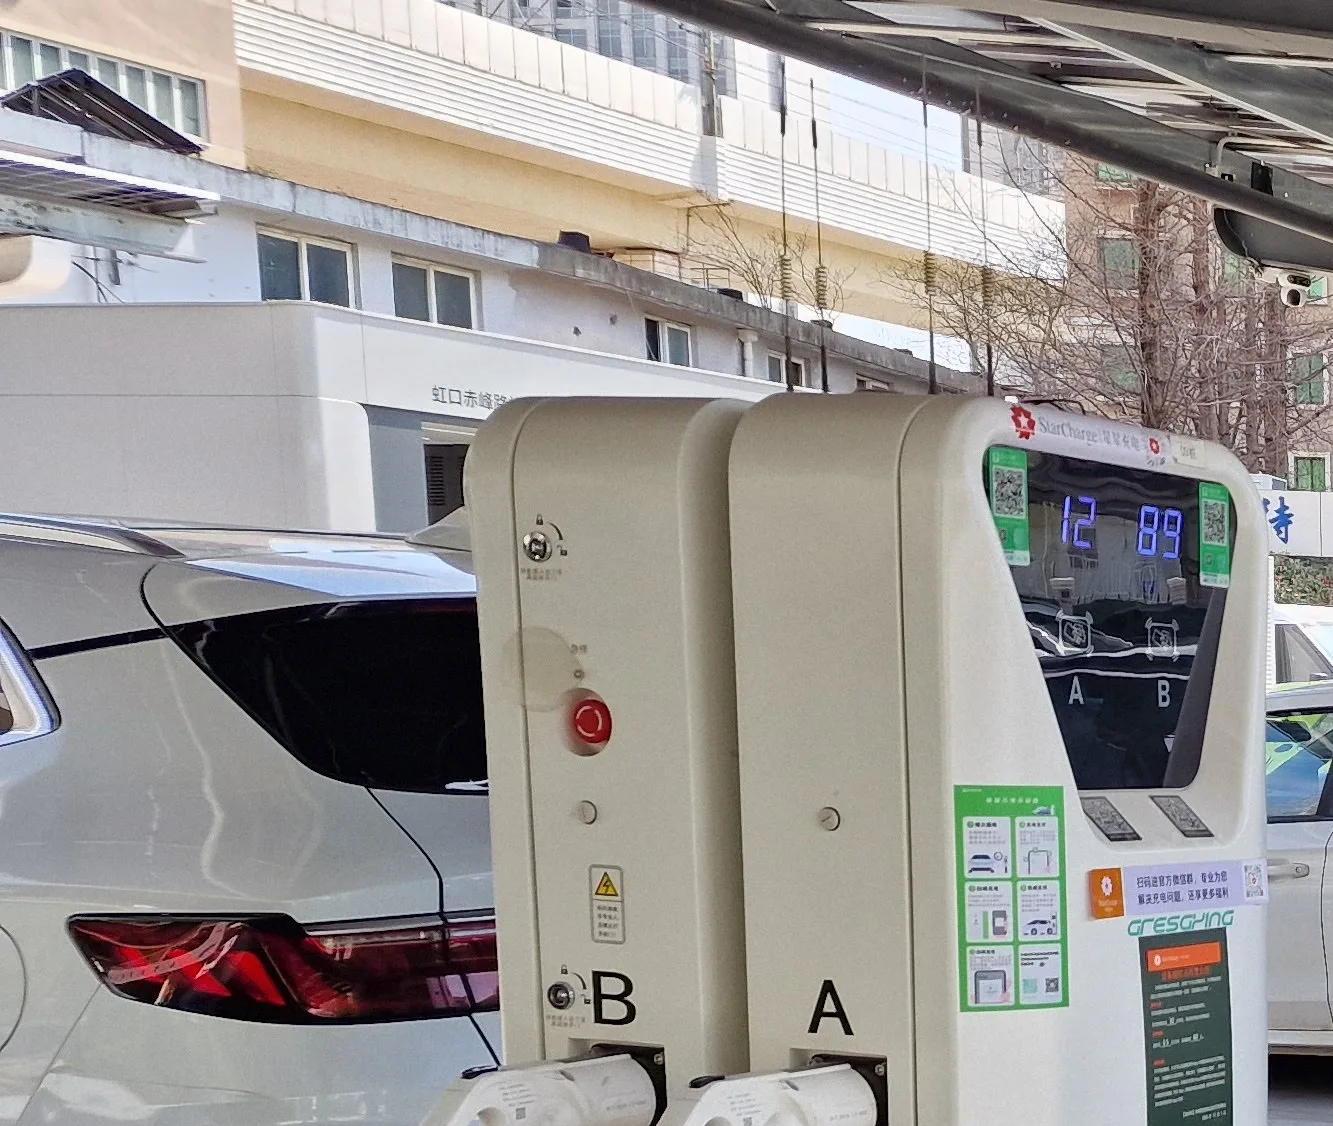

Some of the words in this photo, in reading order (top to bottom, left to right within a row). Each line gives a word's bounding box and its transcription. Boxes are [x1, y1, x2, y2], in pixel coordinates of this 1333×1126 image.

[1059, 494, 1097, 550] 12
[1136, 503, 1183, 560] 89
[1068, 677, 1084, 706] A
[1158, 680, 1171, 708] B
[591, 970, 637, 1026] B
[807, 979, 854, 1037] A
